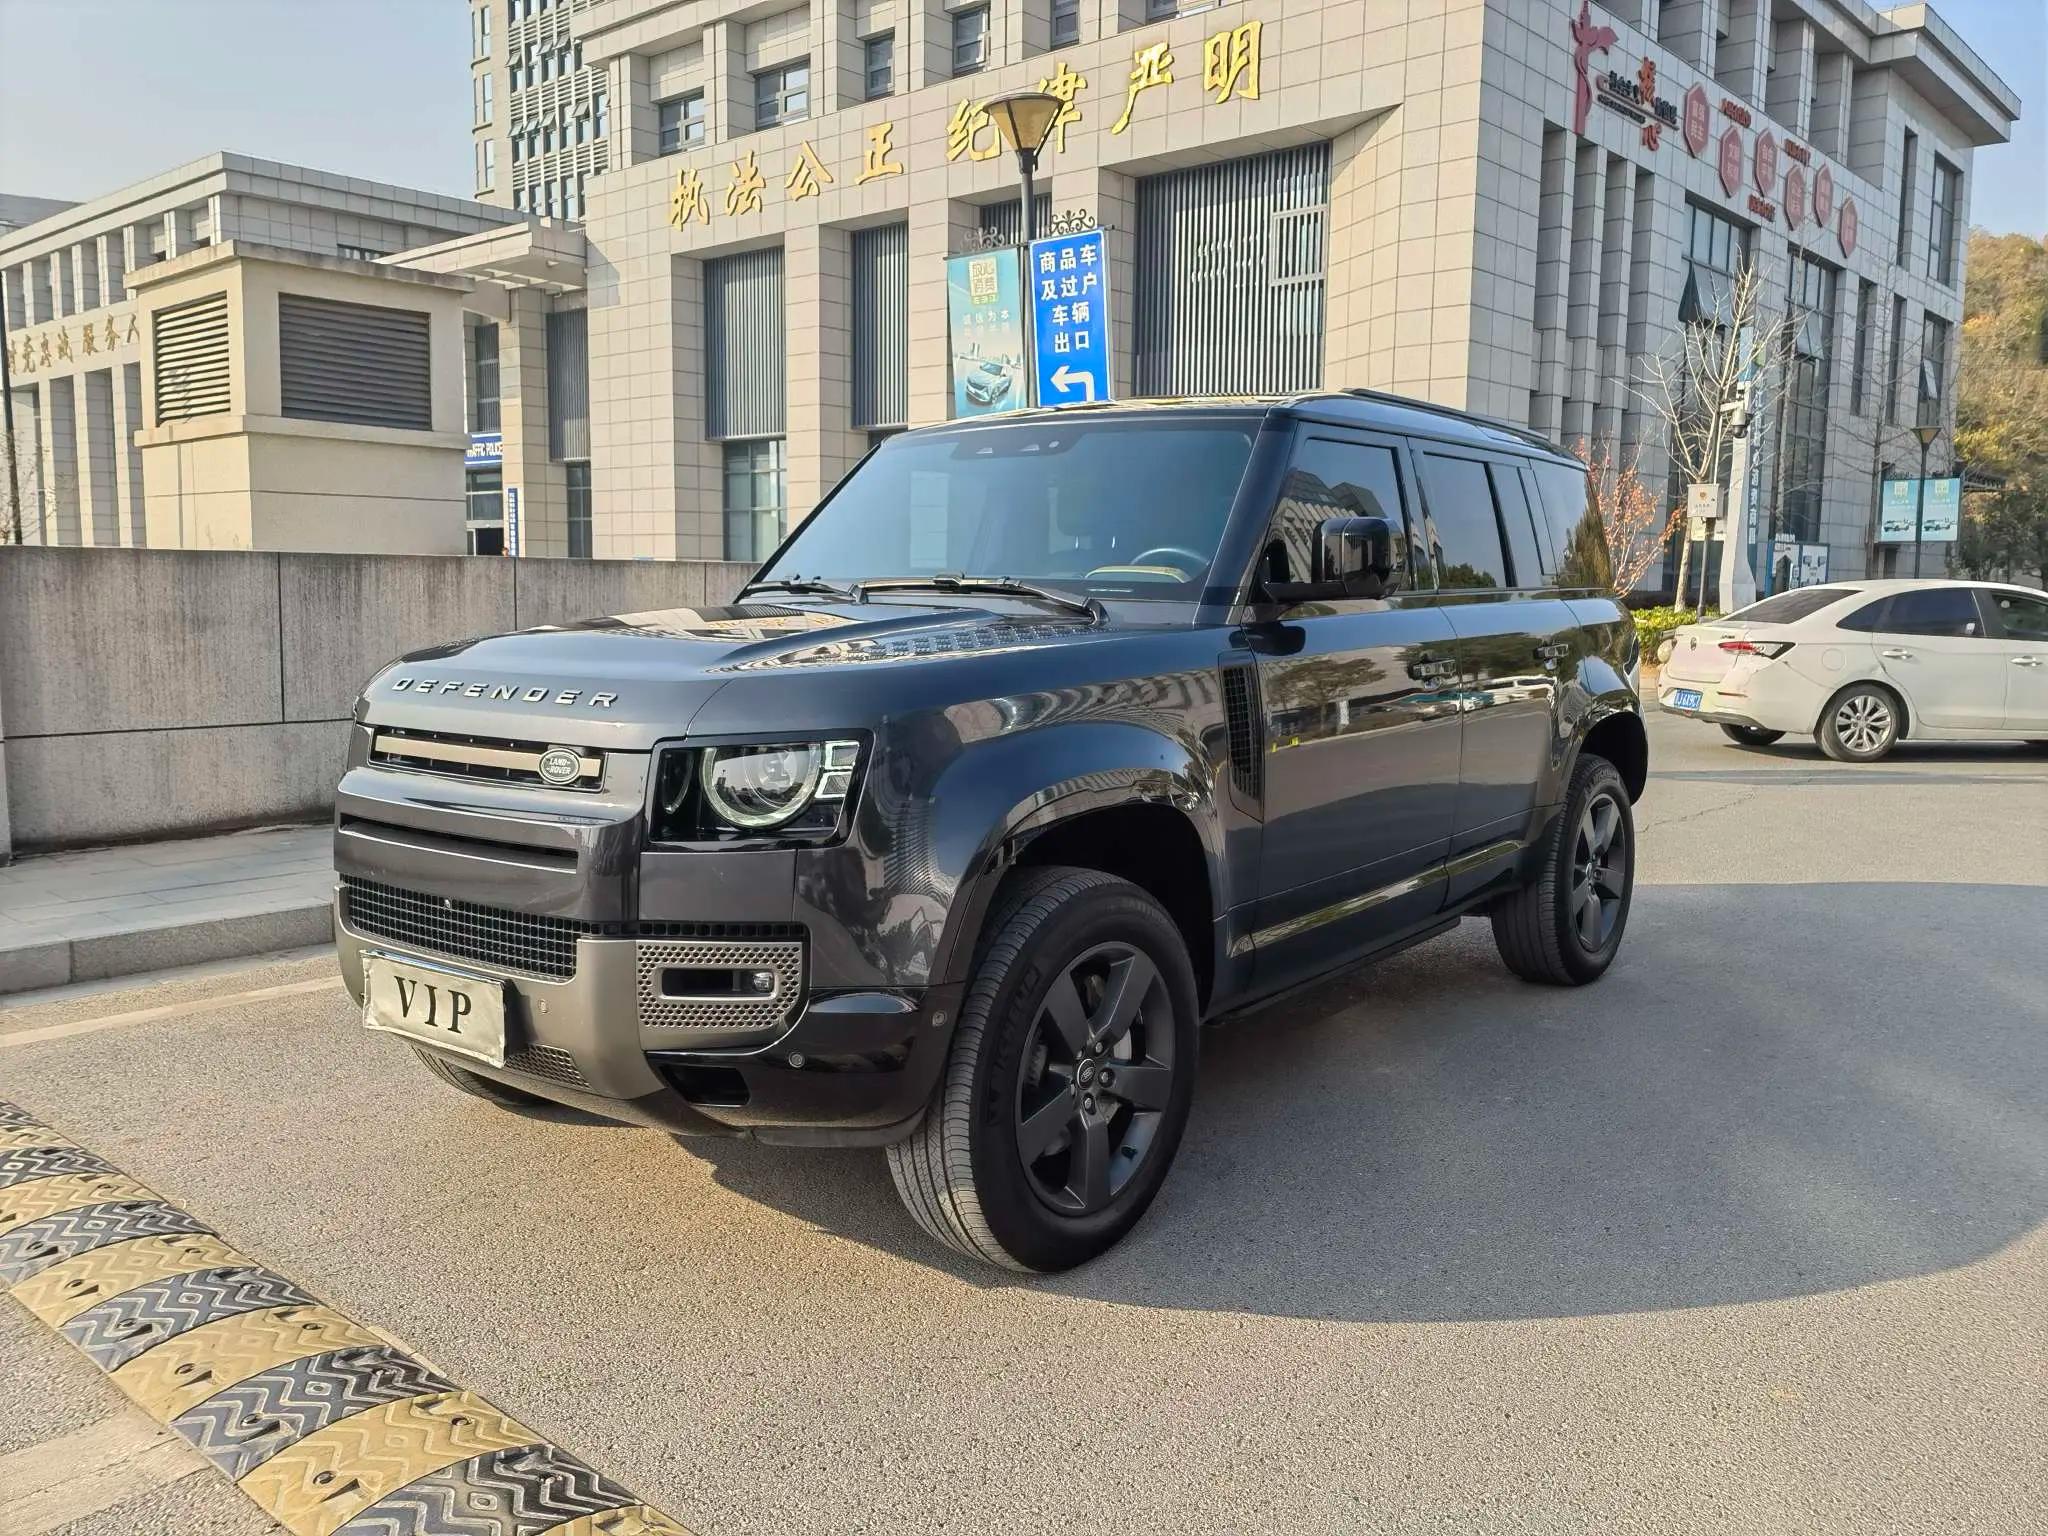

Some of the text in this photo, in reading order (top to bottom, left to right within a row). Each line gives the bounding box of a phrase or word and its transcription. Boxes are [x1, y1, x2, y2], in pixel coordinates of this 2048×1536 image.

[668, 19, 1264, 231] 执法公正 纪律严明
[1038, 243, 1098, 274] 商品车
[1041, 272, 1098, 301] 及过户
[1052, 301, 1090, 326] 车辆
[1054, 330, 1090, 353] 出口
[391, 677, 619, 708] DEFENDER
[549, 757, 568, 766] LAND
[550, 765, 572, 775] ROVER
[393, 975, 472, 1034] VIP
